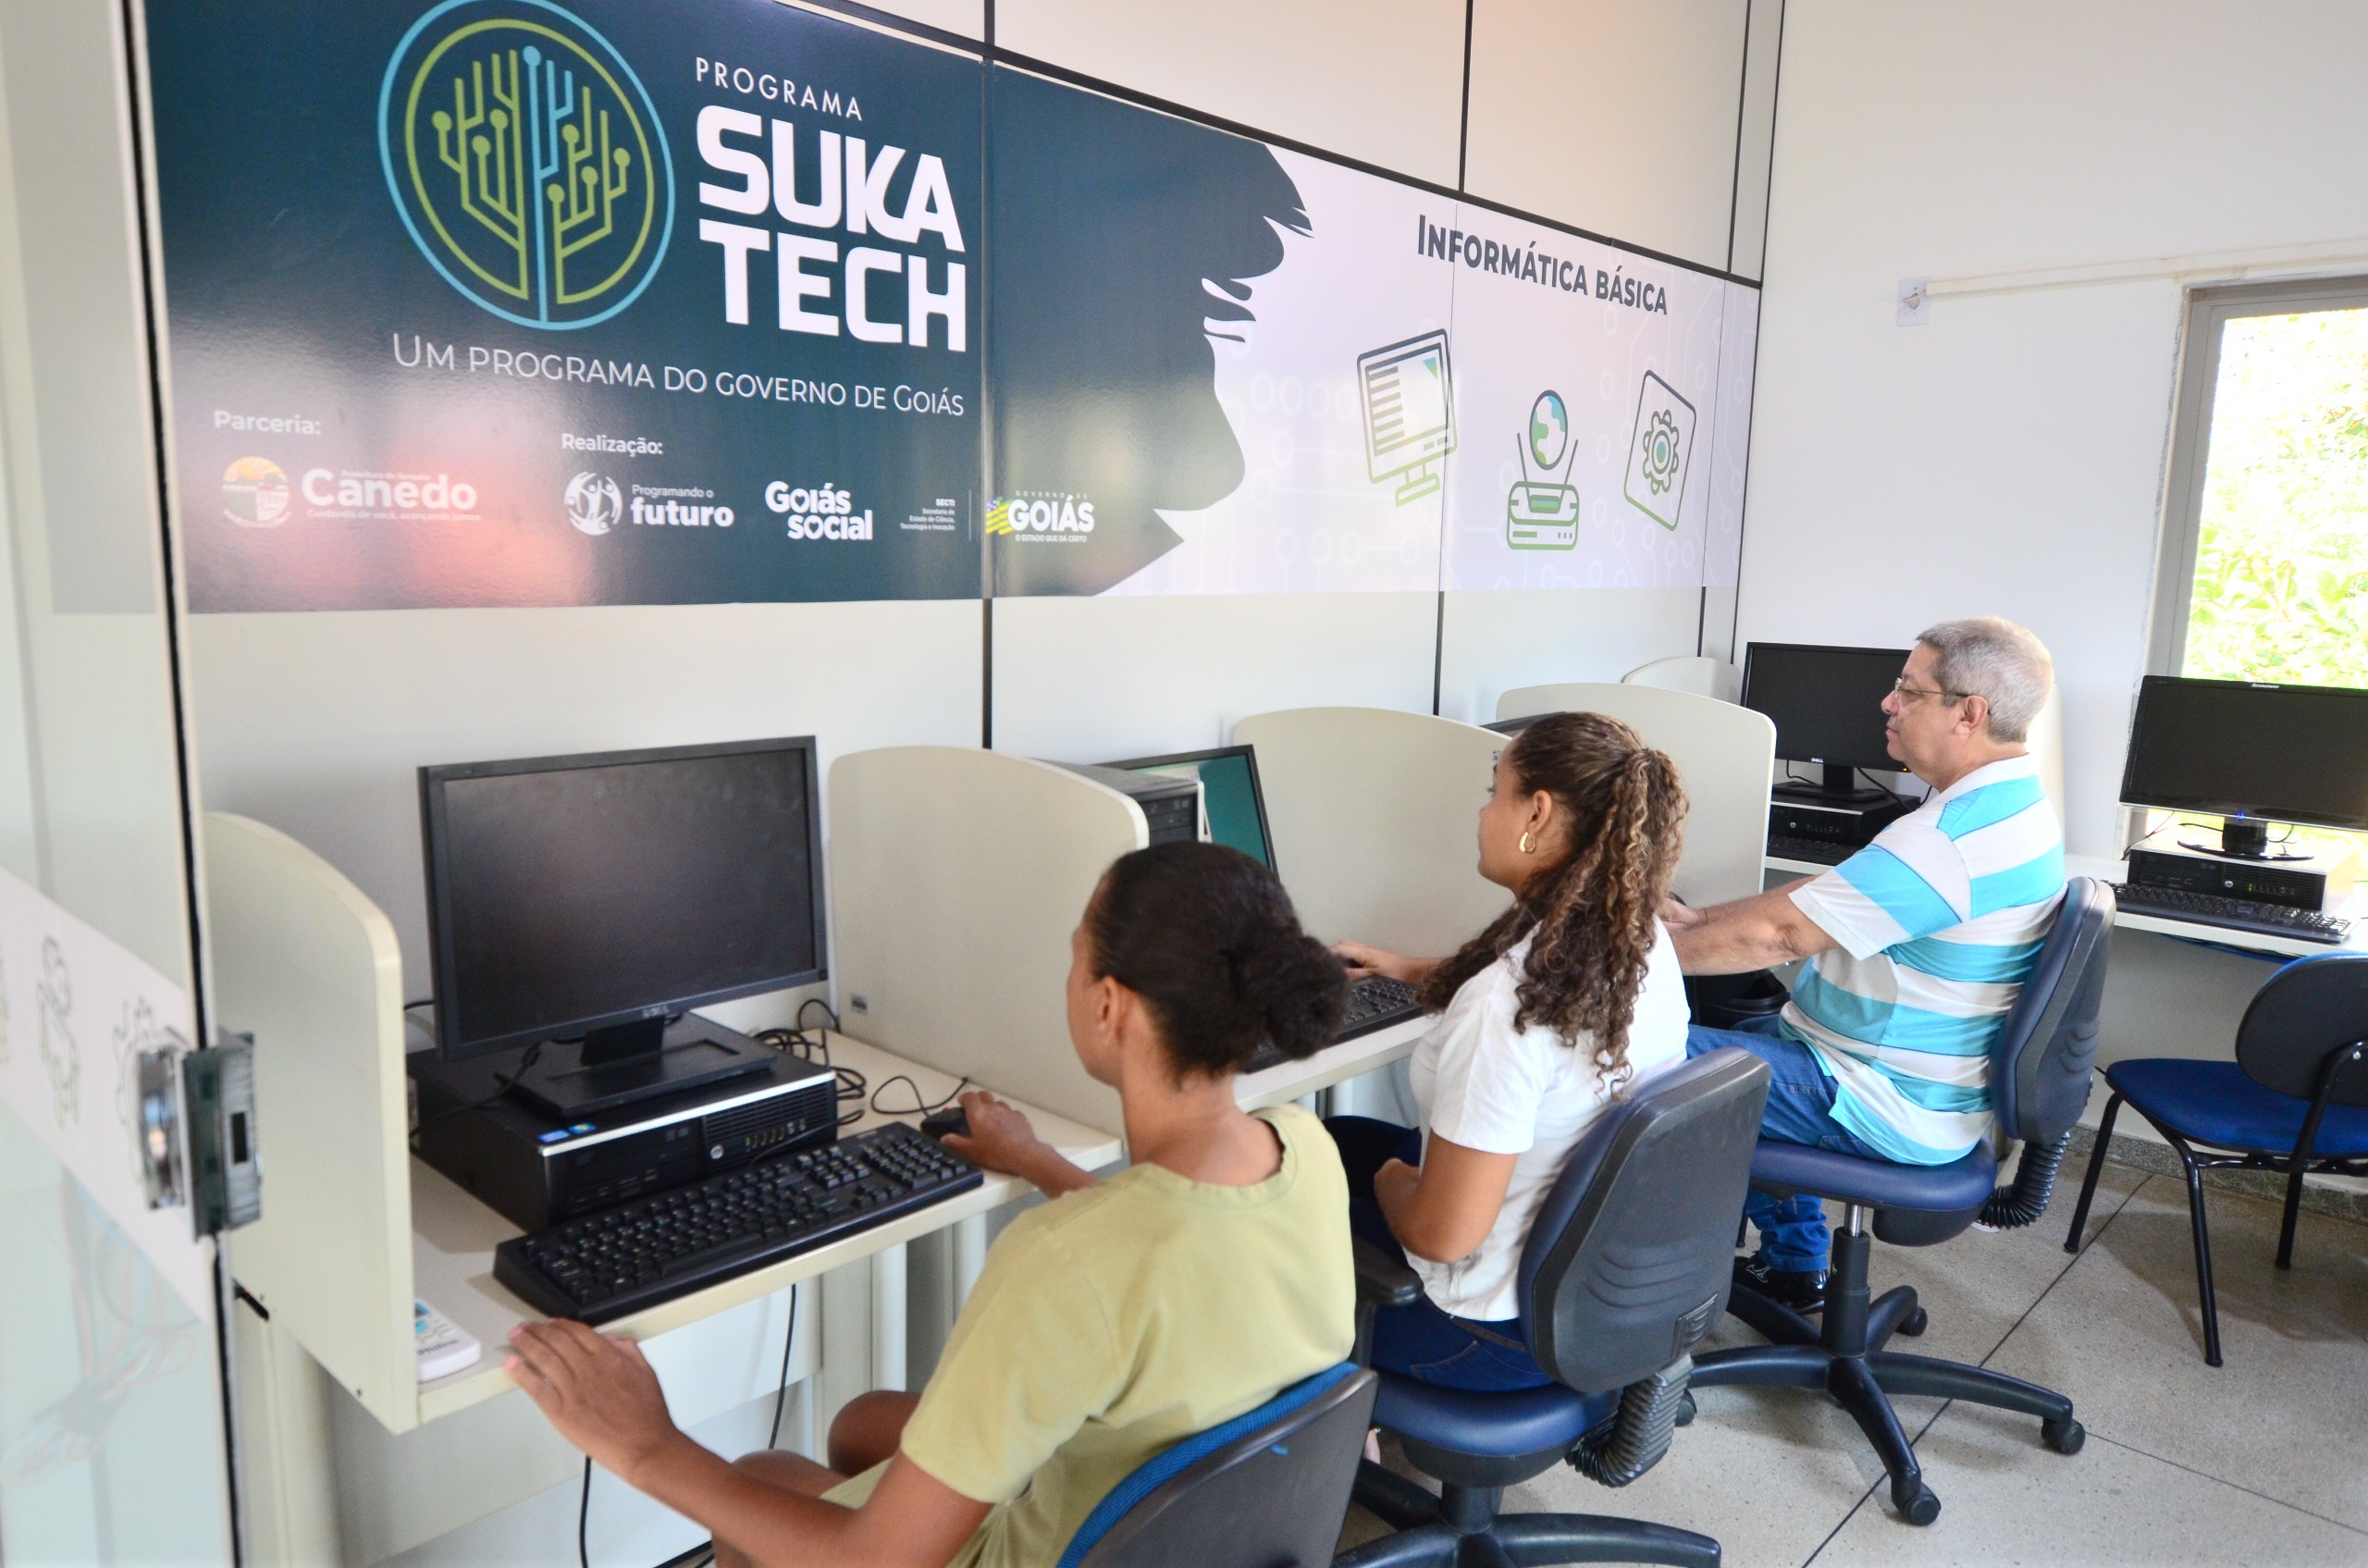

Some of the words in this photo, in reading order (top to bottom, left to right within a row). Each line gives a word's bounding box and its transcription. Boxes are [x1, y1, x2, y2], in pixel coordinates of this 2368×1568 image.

[696, 56, 863, 121] PROGRAMA
[697, 105, 966, 253] SUKA
[1417, 214, 1588, 296] INFORMÁTICA
[1596, 265, 1668, 315] BÁSICA
[698, 218, 967, 352] TECH
[213, 410, 322, 435] Parceria:
[561, 433, 664, 458] Realização:
[302, 468, 476, 510] Canedo
[632, 484, 704, 499] Programando
[706, 489, 714, 499] o
[765, 480, 852, 514] Goiás
[1015, 489, 1066, 499] GOVERNO
[630, 497, 735, 527] futuro
[787, 509, 873, 540] social
[1007, 494, 1095, 533] GOIÁS
[1021, 534, 1045, 542] ESTADO
[1067, 535, 1088, 543] CERTO
